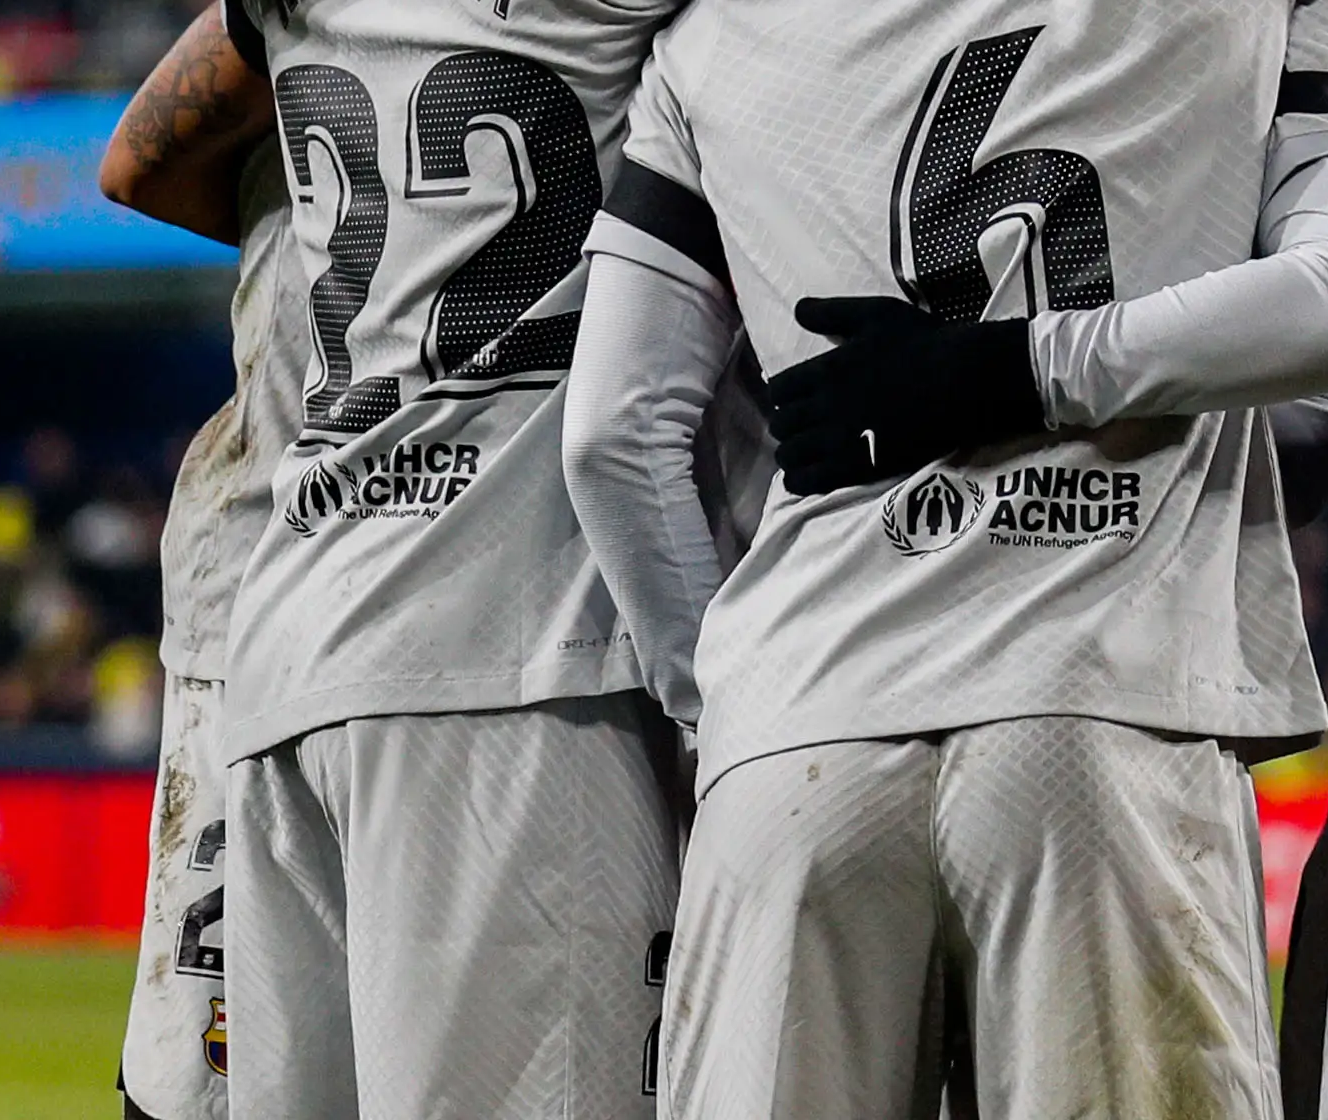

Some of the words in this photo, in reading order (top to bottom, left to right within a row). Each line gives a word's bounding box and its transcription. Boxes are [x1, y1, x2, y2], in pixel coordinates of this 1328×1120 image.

[889, 24, 1114, 320] 6
[274, 50, 602, 448] 22
[996, 466, 1141, 502] UNHCR
[988, 499, 1139, 533] ACNUR
[988, 532, 1011, 546] The
[1012, 535, 1032, 547] UN
[1034, 536, 1089, 550] Refugee
[1091, 530, 1136, 543] Agency
